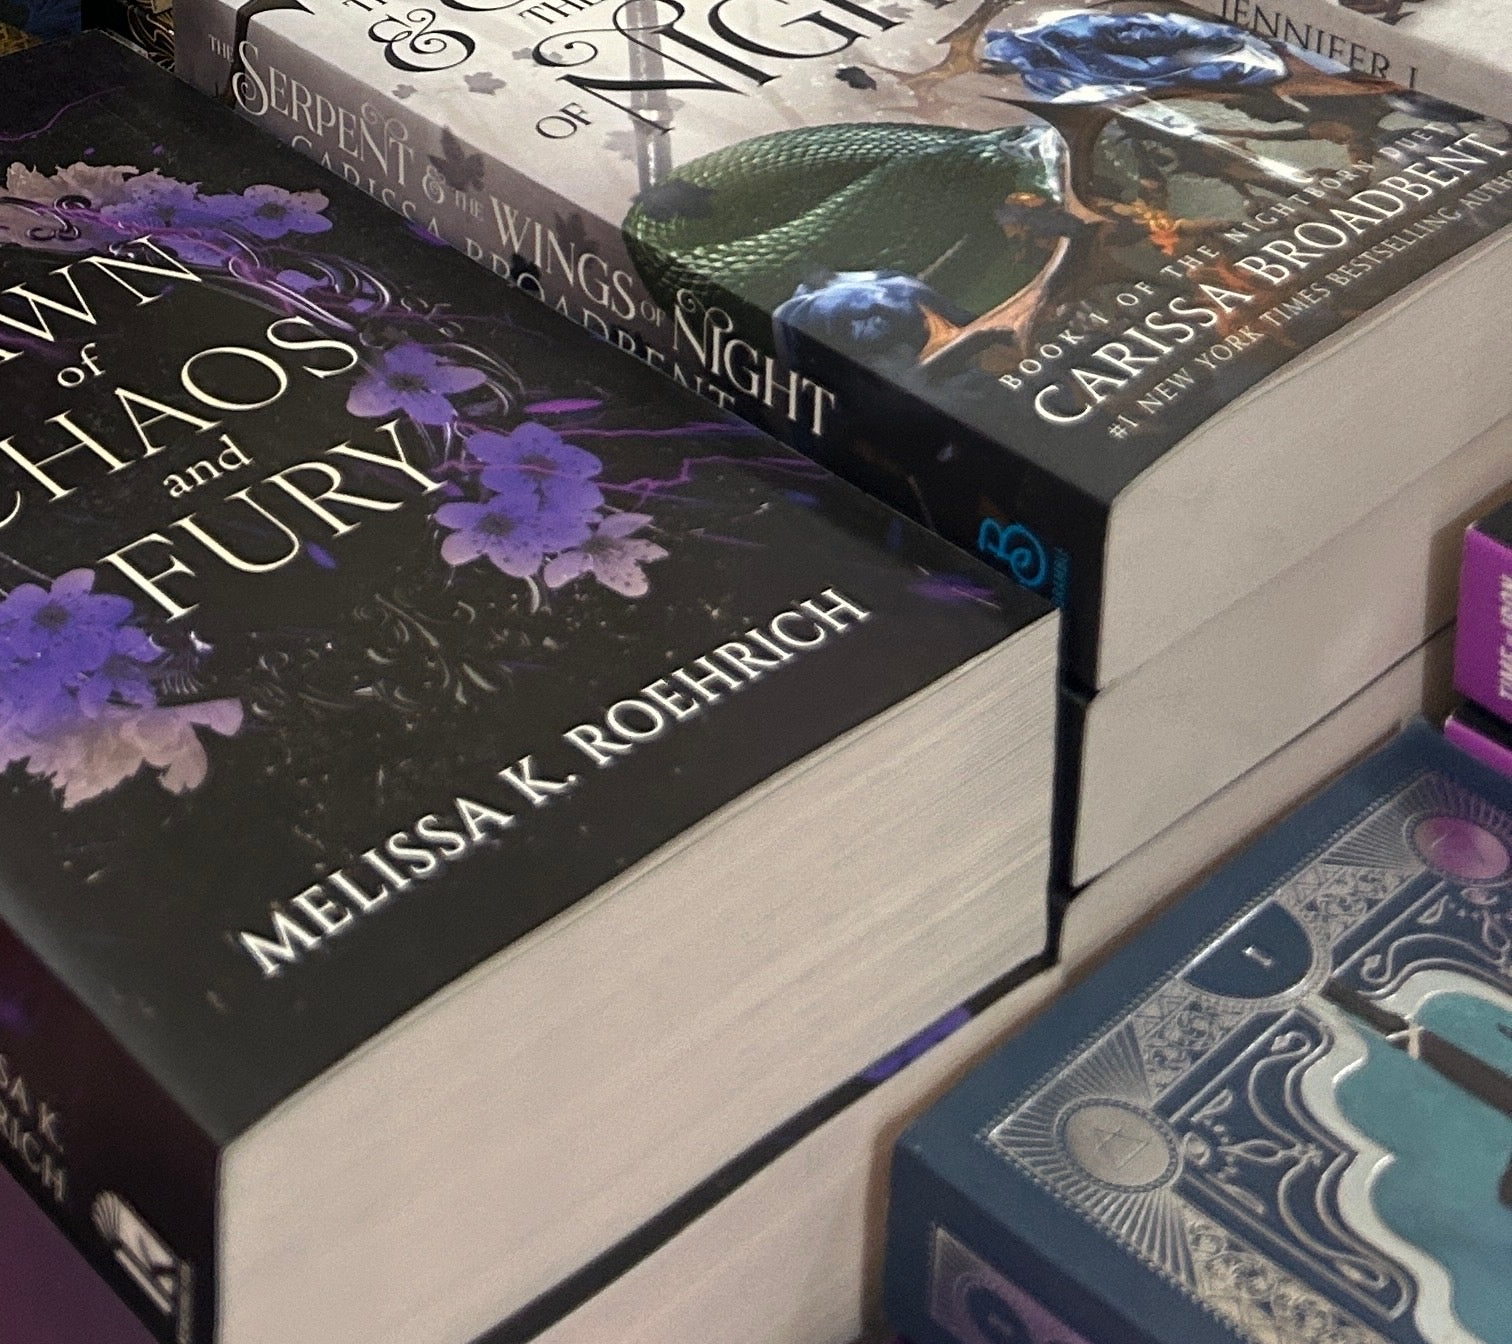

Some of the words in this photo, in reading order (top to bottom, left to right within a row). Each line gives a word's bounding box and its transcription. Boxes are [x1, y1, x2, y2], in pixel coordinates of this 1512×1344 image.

[368, 7, 476, 72] &
[535, 102, 594, 142] OF
[208, 33, 235, 66] THE
[231, 38, 416, 189] SERPENT
[421, 166, 447, 205] &
[454, 189, 484, 220] THE
[488, 195, 636, 320] WINGS
[640, 297, 666, 328] OF
[673, 287, 836, 438] NIGHT
[1000, 324, 1082, 392] BOOK
[1116, 278, 1156, 308] OF
[1161, 245, 1220, 281] THE
[1223, 158, 1378, 245] NIGHTBORN
[1379, 122, 1446, 162] DUET
[1033, 275, 1257, 426] CARISSA
[1233, 132, 1508, 287] BROADBENT
[1106, 408, 1138, 441] #1
[1137, 371, 1196, 416] NEW
[1193, 324, 1265, 369] YORK
[1264, 282, 1332, 331] TIMES
[1325, 206, 1462, 287] BESTSELLING
[55, 341, 106, 390] of
[161, 433, 253, 500] and
[96, 417, 446, 624] FURY
[238, 795, 516, 979] MELISSA
[498, 753, 579, 808] K.
[563, 586, 873, 768] ROEHRICH
